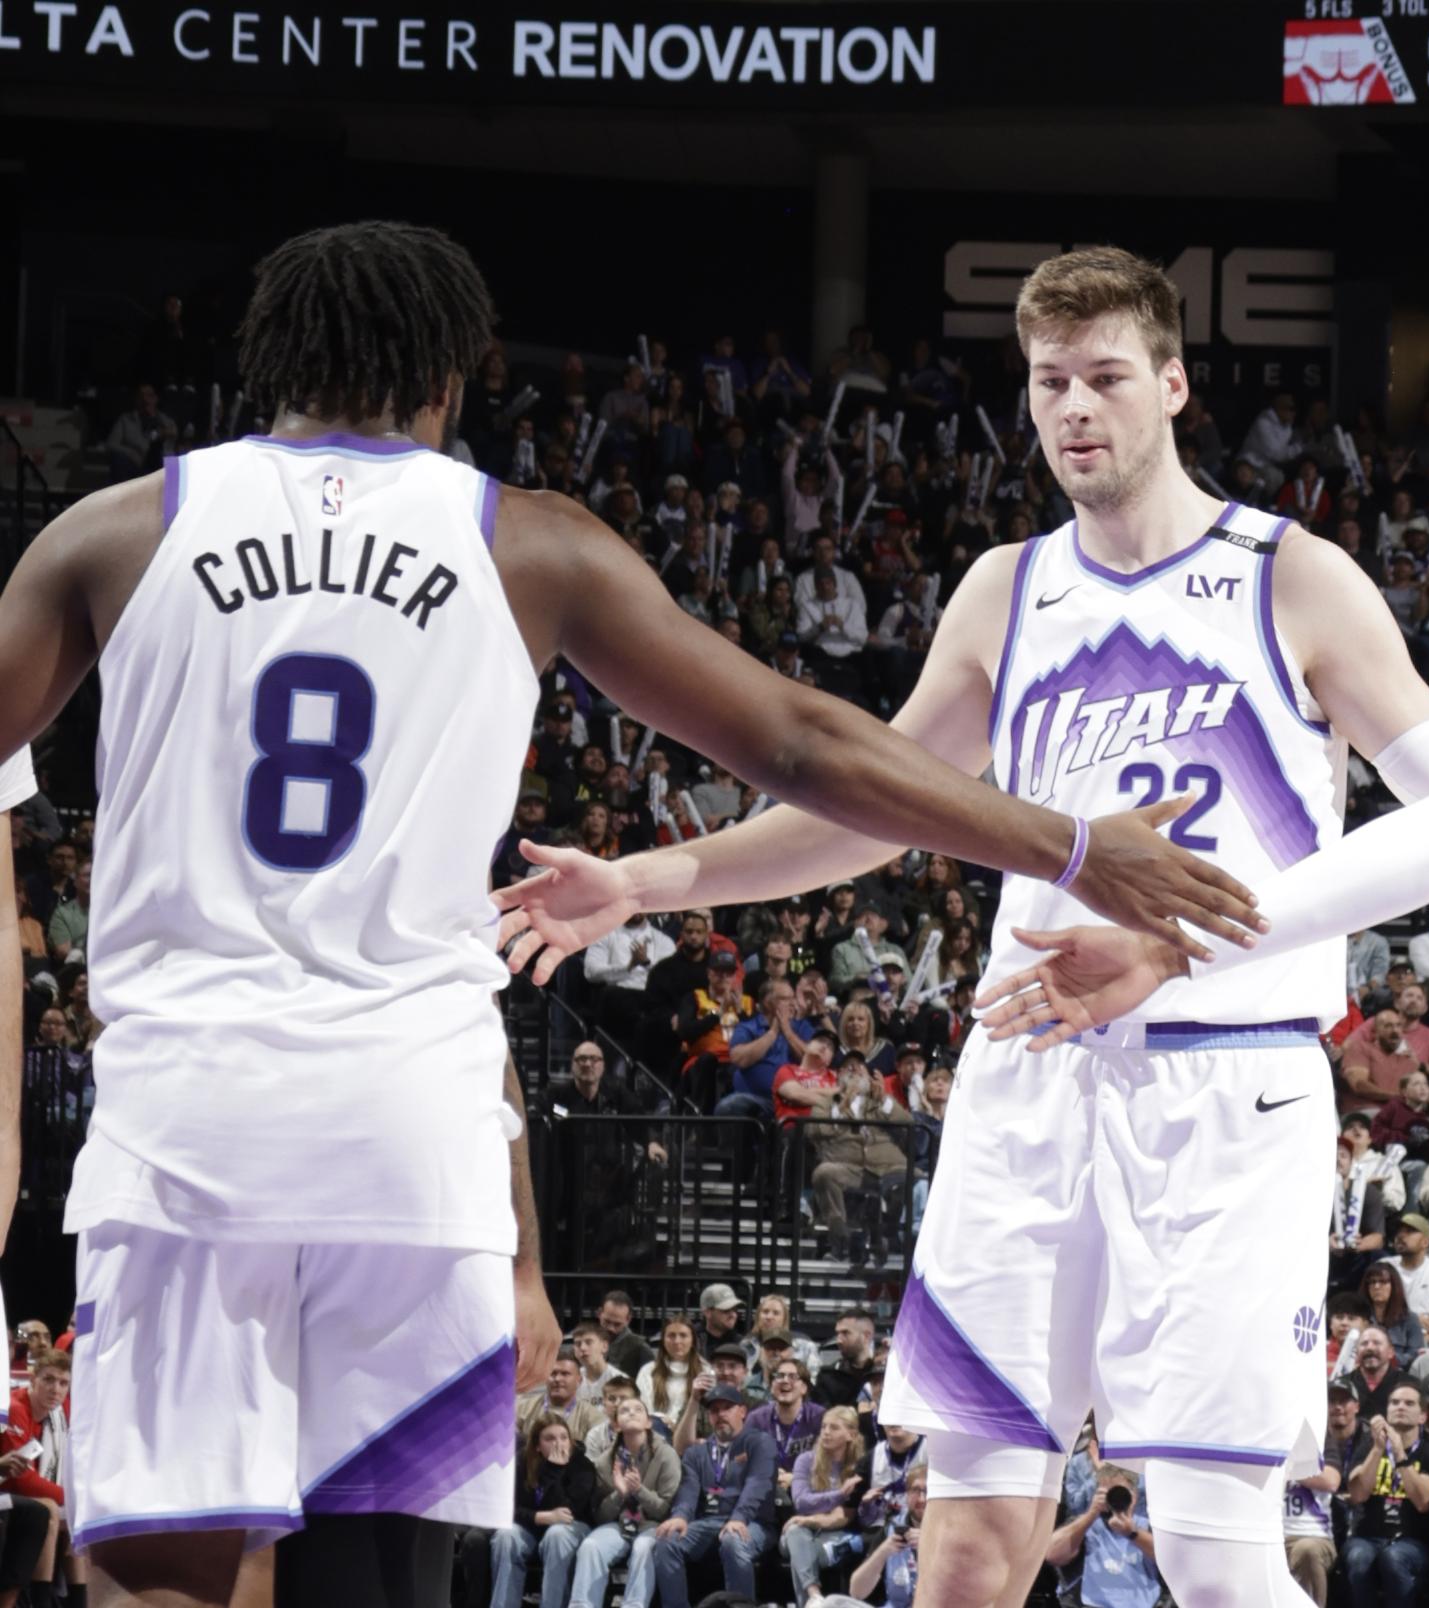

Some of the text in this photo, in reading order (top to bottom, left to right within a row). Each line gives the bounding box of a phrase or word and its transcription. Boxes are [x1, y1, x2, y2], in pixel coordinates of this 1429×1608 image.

[173, 9, 478, 71] CENTER
[513, 21, 935, 83] RENOVATION
[1366, 22, 1410, 98] BONUS
[193, 528, 459, 631] COLLIER
[1185, 573, 1243, 601] LVT
[240, 650, 377, 874] 8
[1014, 681, 1247, 807] UTAH
[1117, 760, 1222, 853] 22
[1284, 1495, 1303, 1516] 19
